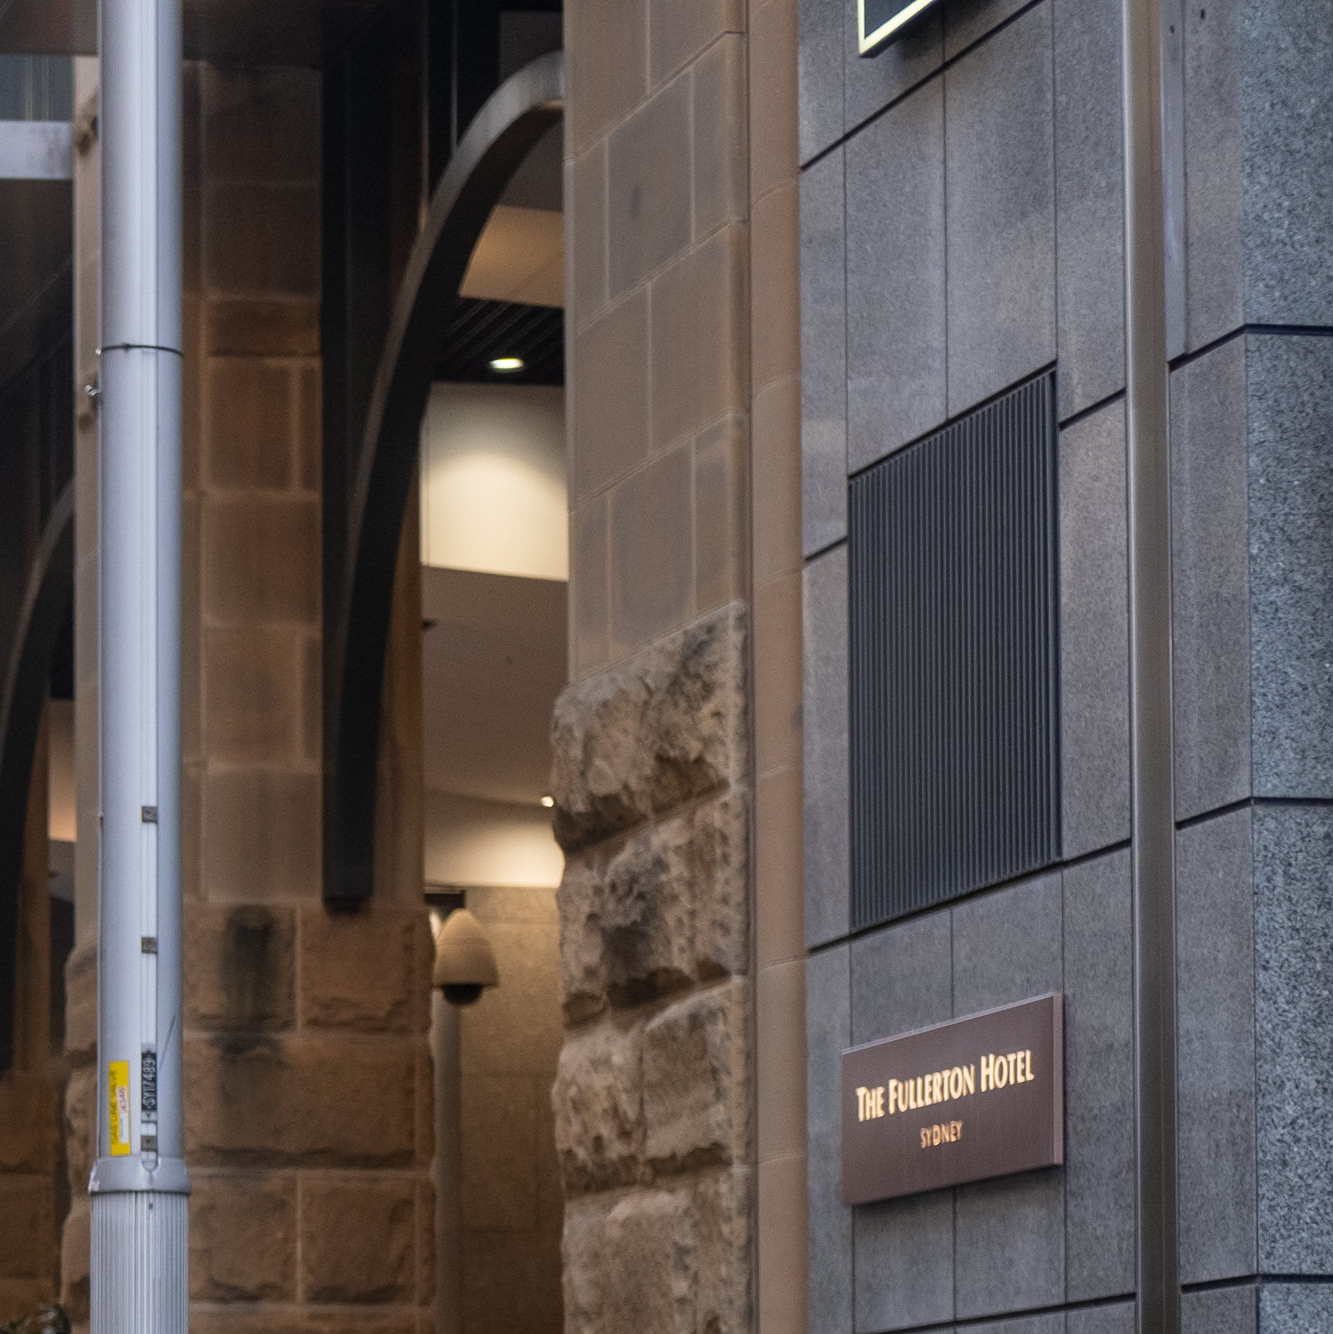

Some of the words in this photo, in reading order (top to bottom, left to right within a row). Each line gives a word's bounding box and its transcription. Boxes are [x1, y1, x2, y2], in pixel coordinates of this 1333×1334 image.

[855, 1085, 886, 1122] THE
[887, 1063, 976, 1115] FULLERTON
[980, 1049, 1035, 1093] HOTEL
[920, 1119, 963, 1149] SYDNEY
